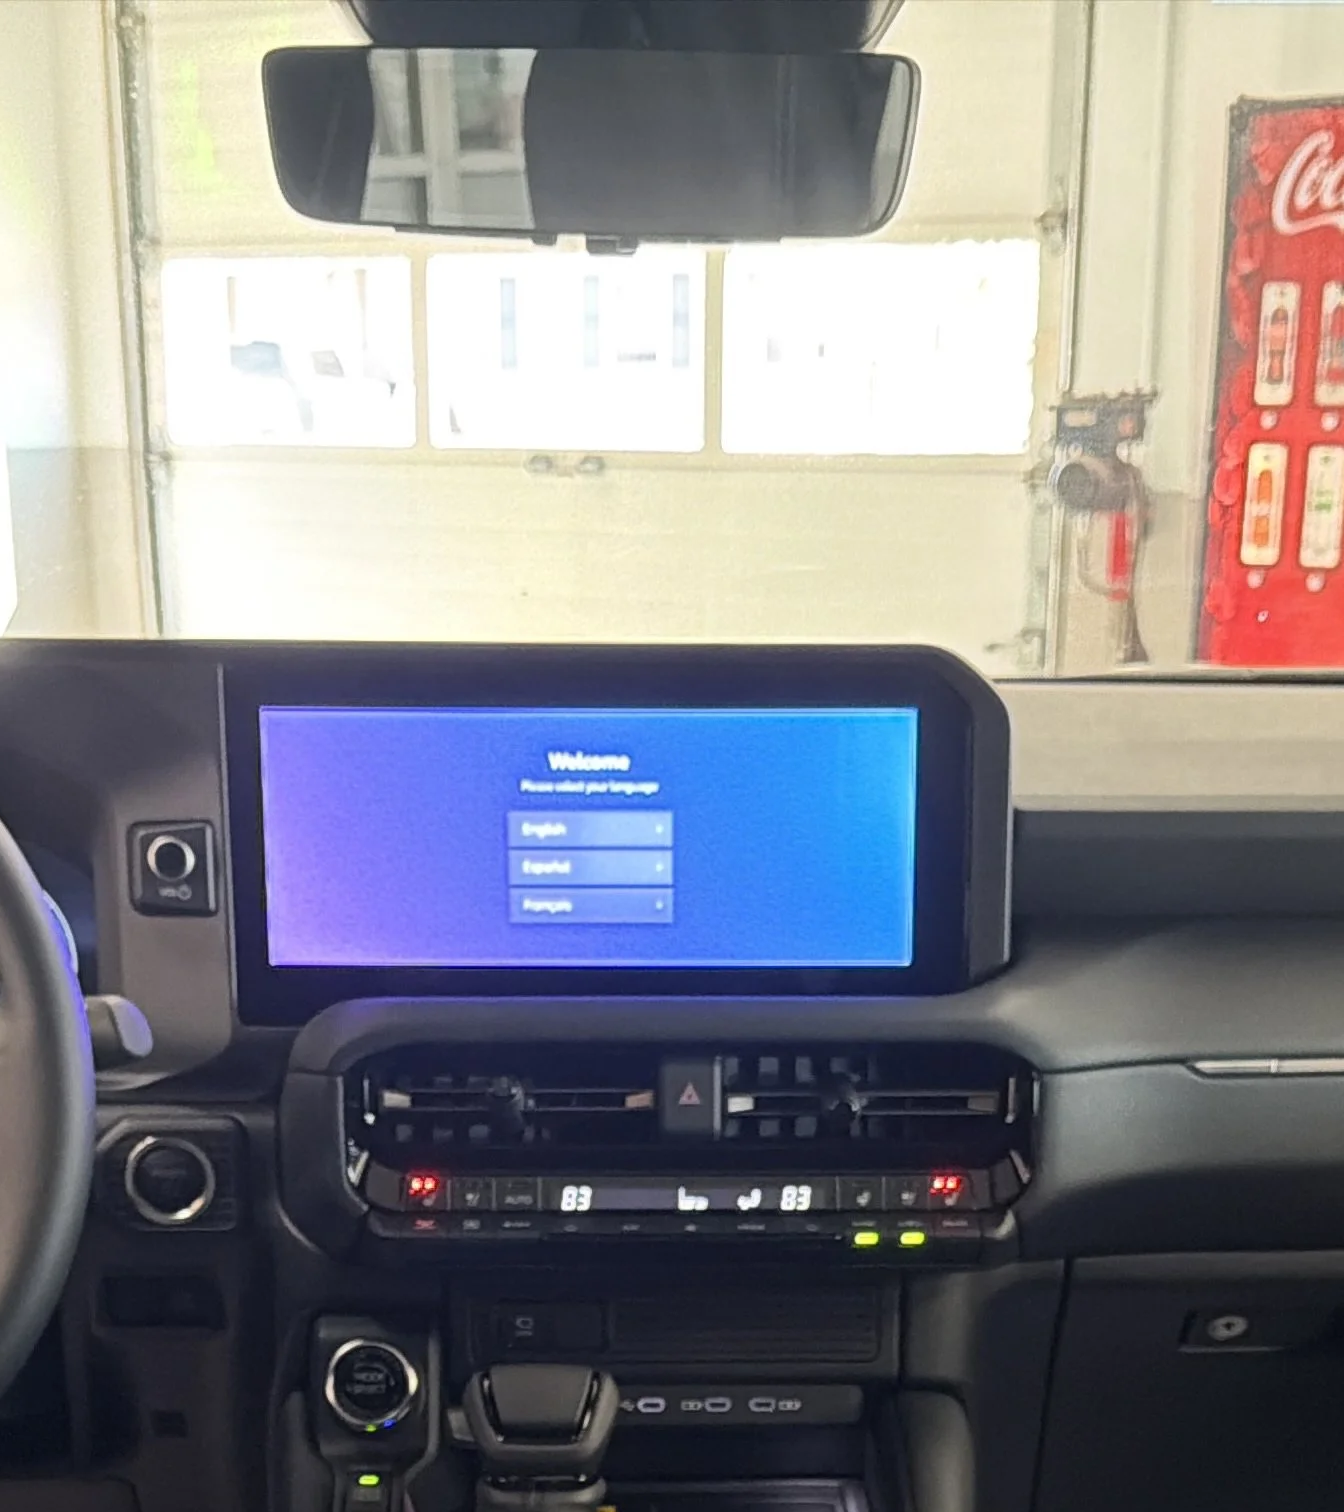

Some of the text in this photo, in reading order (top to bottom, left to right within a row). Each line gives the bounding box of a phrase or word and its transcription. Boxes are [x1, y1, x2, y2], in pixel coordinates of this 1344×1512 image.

[547, 750, 631, 771] Welcome
[521, 822, 567, 840] English
[560, 1185, 593, 1212] 83
[780, 1185, 812, 1211] 83
